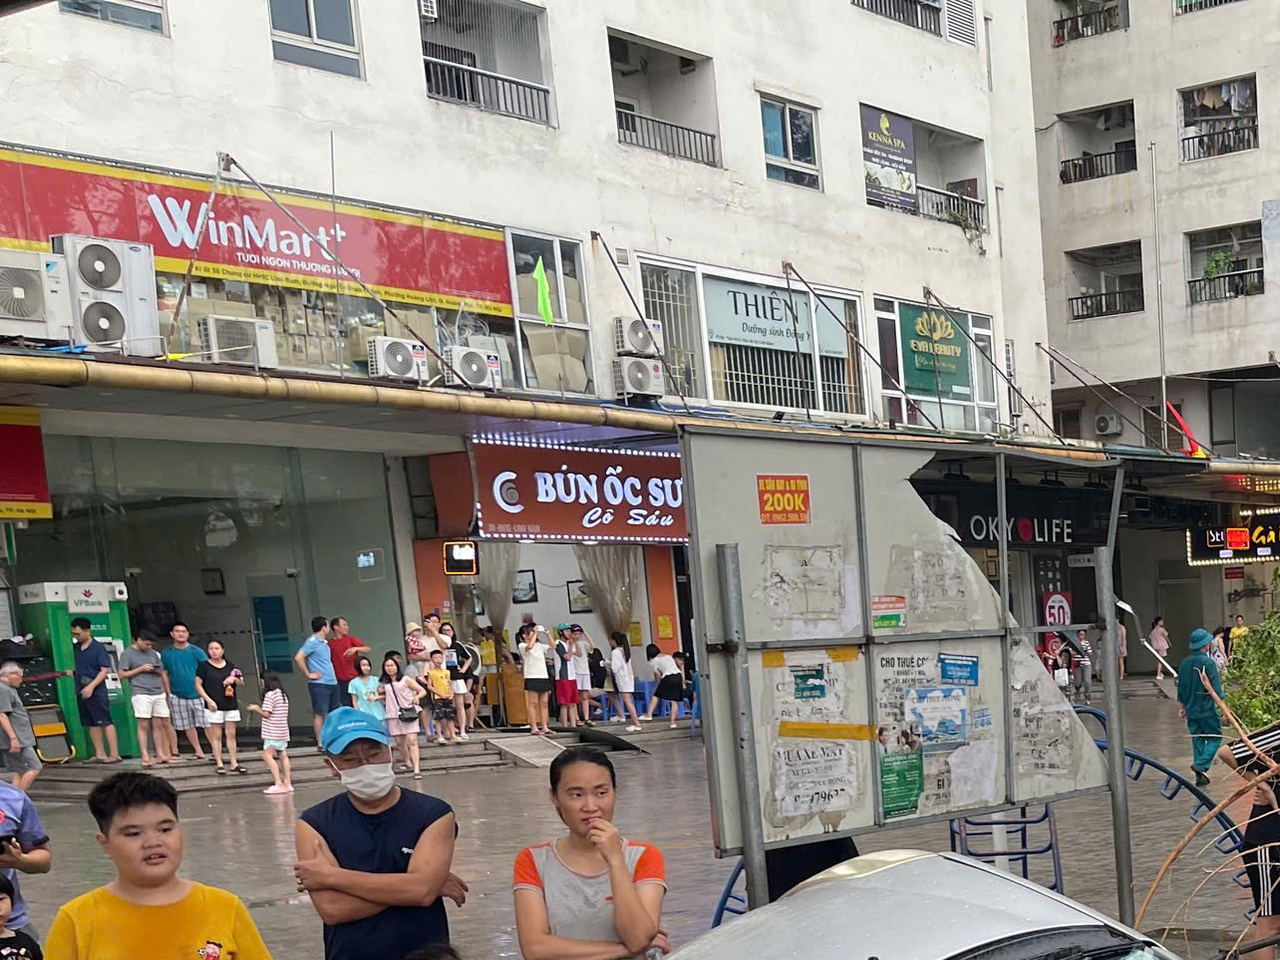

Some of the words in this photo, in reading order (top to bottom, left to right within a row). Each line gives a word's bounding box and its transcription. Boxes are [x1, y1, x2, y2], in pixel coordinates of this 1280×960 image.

[868, 132, 893, 146] KENNA
[893, 139, 906, 150] SPA
[262, 255, 290, 269] NGON
[727, 290, 799, 324] THIÊN
[742, 322, 767, 336] Dưỡng
[768, 328, 784, 337] sinh
[534, 464, 598, 504] BÚN
[603, 465, 641, 506] ỐC
[763, 493, 806, 511] 200K
[582, 507, 614, 528] Cô
[627, 509, 674, 527] Sáu
[1034, 518, 1072, 543] LIFE
[1252, 525, 1275, 545] Gà
[73, 599, 103, 607] VPBank
[880, 657, 895, 668] CHO
[897, 655, 915, 668] THUÊ
